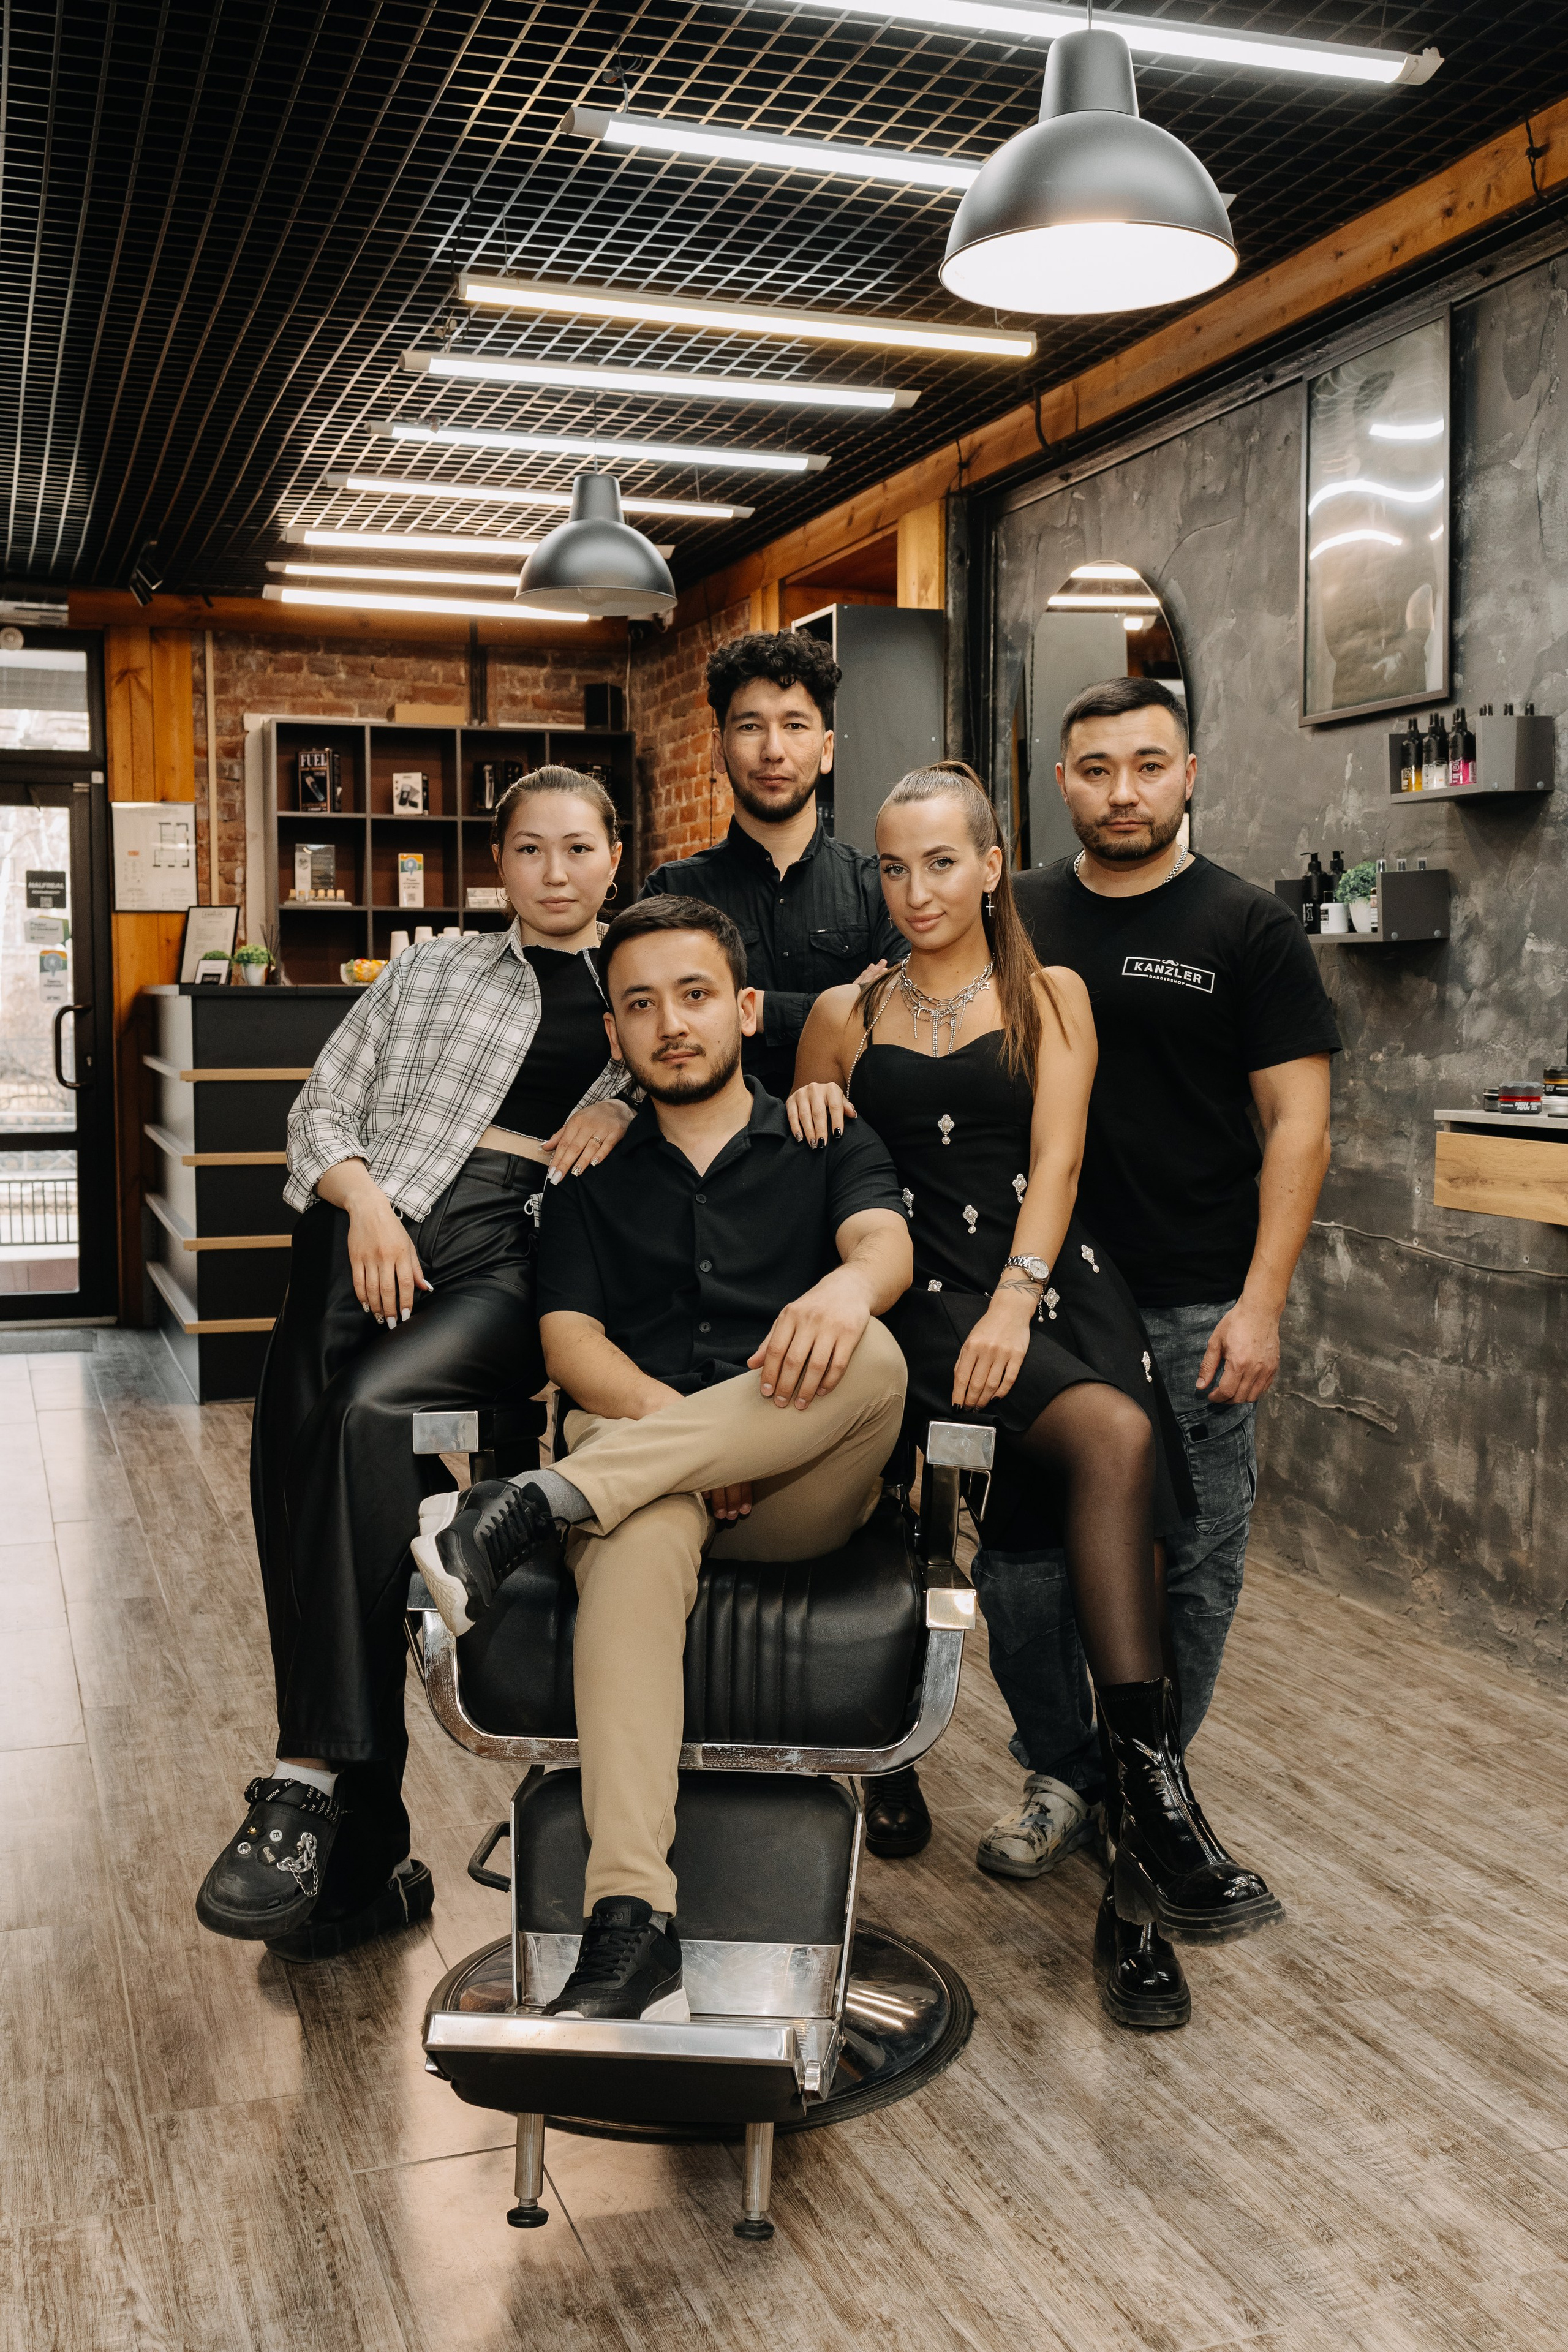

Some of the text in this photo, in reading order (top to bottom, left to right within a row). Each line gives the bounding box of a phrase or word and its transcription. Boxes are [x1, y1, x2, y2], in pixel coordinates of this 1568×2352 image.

[300, 753, 328, 767] FUEL
[1134, 962, 1202, 984] KANZLER
[1148, 974, 1185, 985] BARBERSHOP
